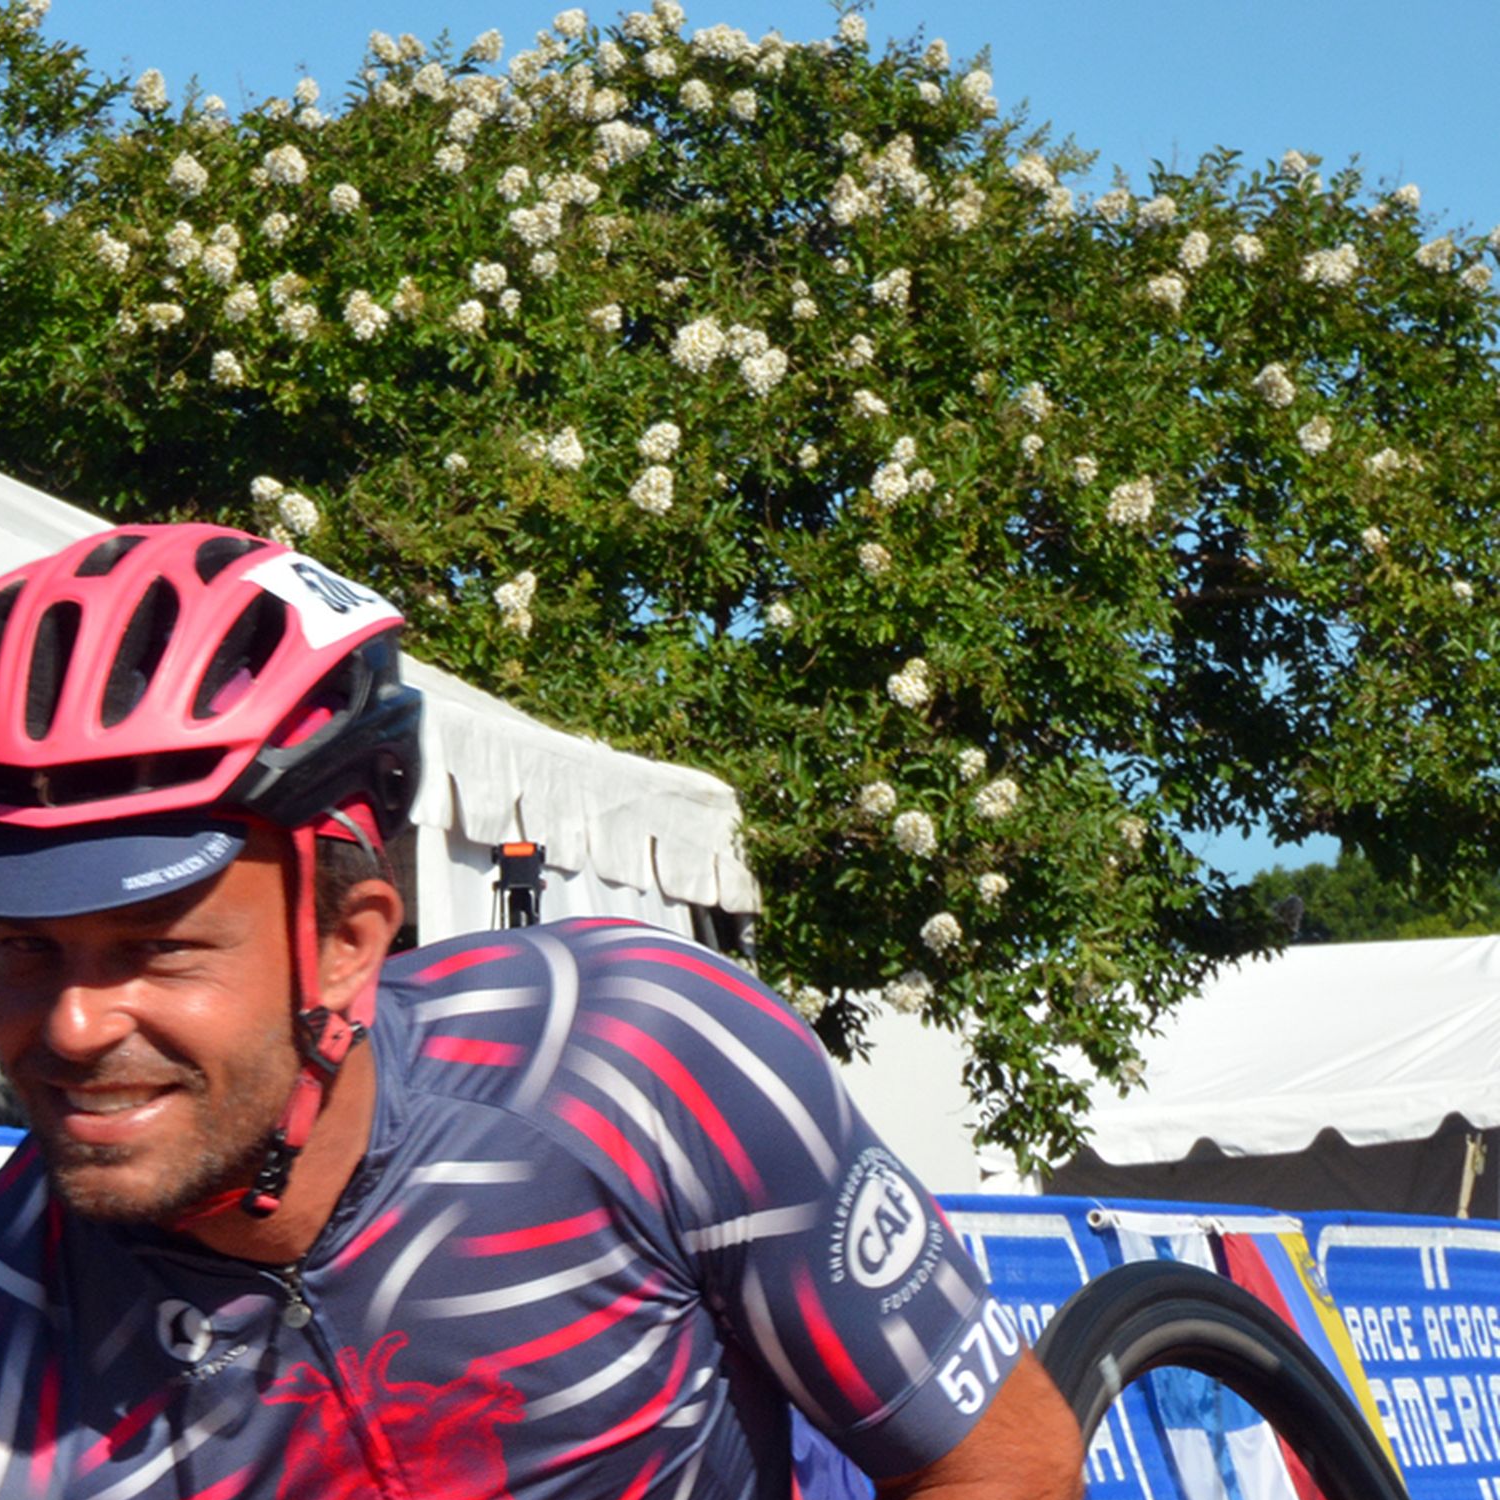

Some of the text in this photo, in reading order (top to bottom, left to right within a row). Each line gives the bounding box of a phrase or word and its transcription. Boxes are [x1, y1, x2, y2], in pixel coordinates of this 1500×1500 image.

[857, 1186, 914, 1275] CAF
[880, 1219, 945, 1315] FOUNDATION
[936, 1297, 1020, 1415] 570
[1343, 1306, 1421, 1362] RACE
